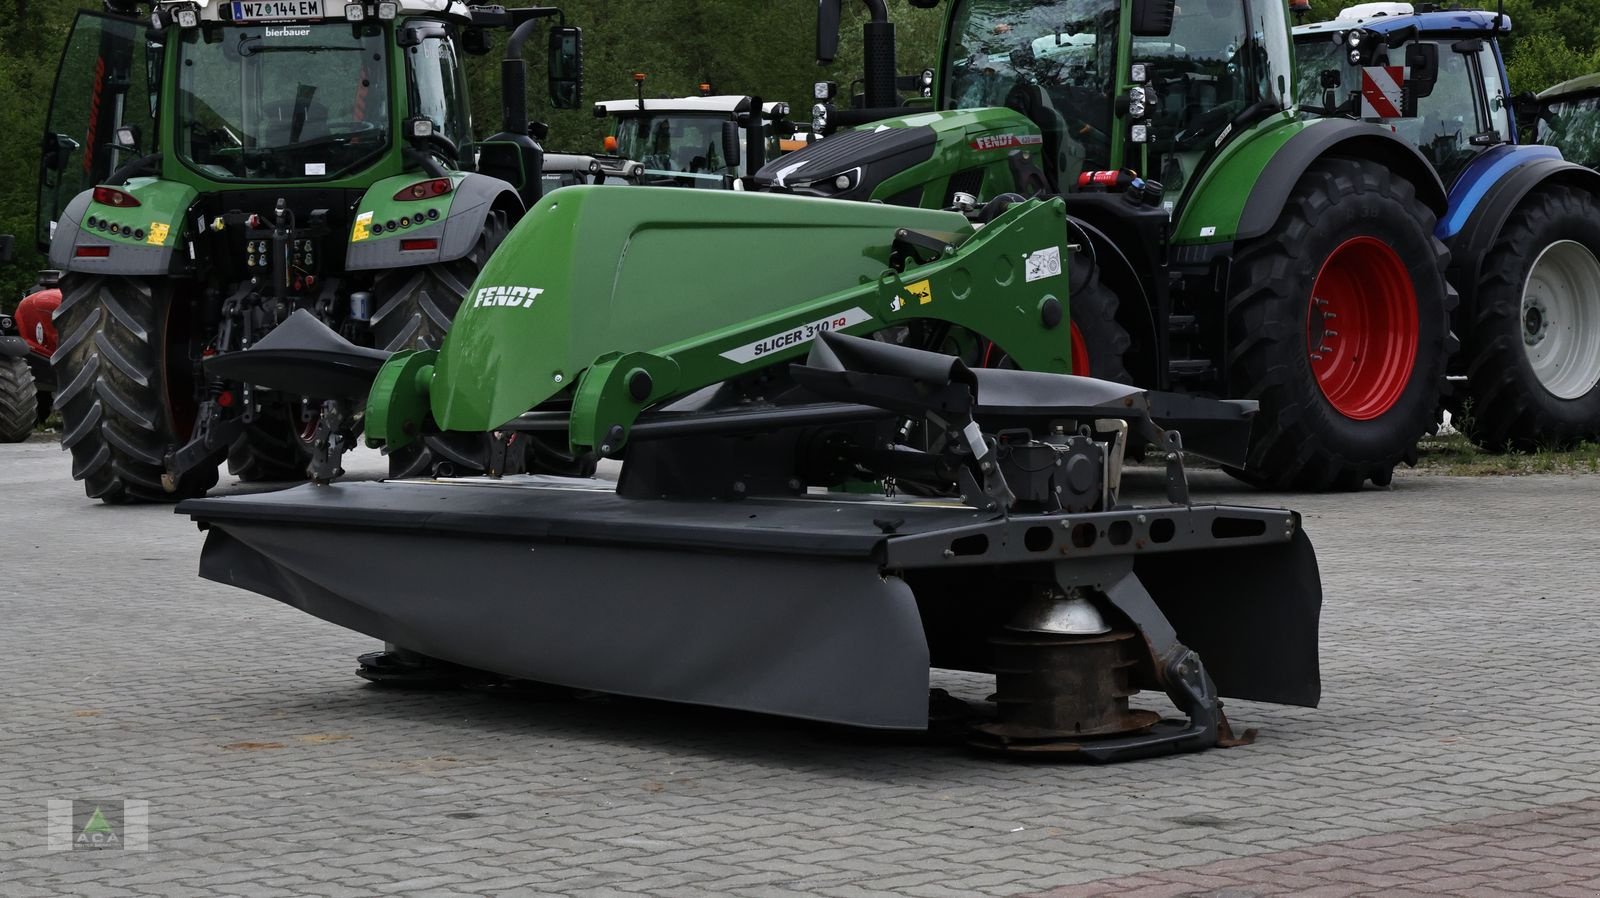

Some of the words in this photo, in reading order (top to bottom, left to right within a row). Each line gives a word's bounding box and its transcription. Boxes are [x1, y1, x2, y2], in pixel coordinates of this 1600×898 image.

[243, 3, 263, 17] WZ
[273, 3, 297, 16] 144
[300, 1, 318, 15] EM
[265, 26, 311, 37] bierbauer
[976, 133, 1014, 150] FENDT
[473, 286, 545, 308] FENDT
[754, 330, 803, 356] SLICER
[806, 320, 829, 338] 310
[832, 317, 847, 329] FQ
